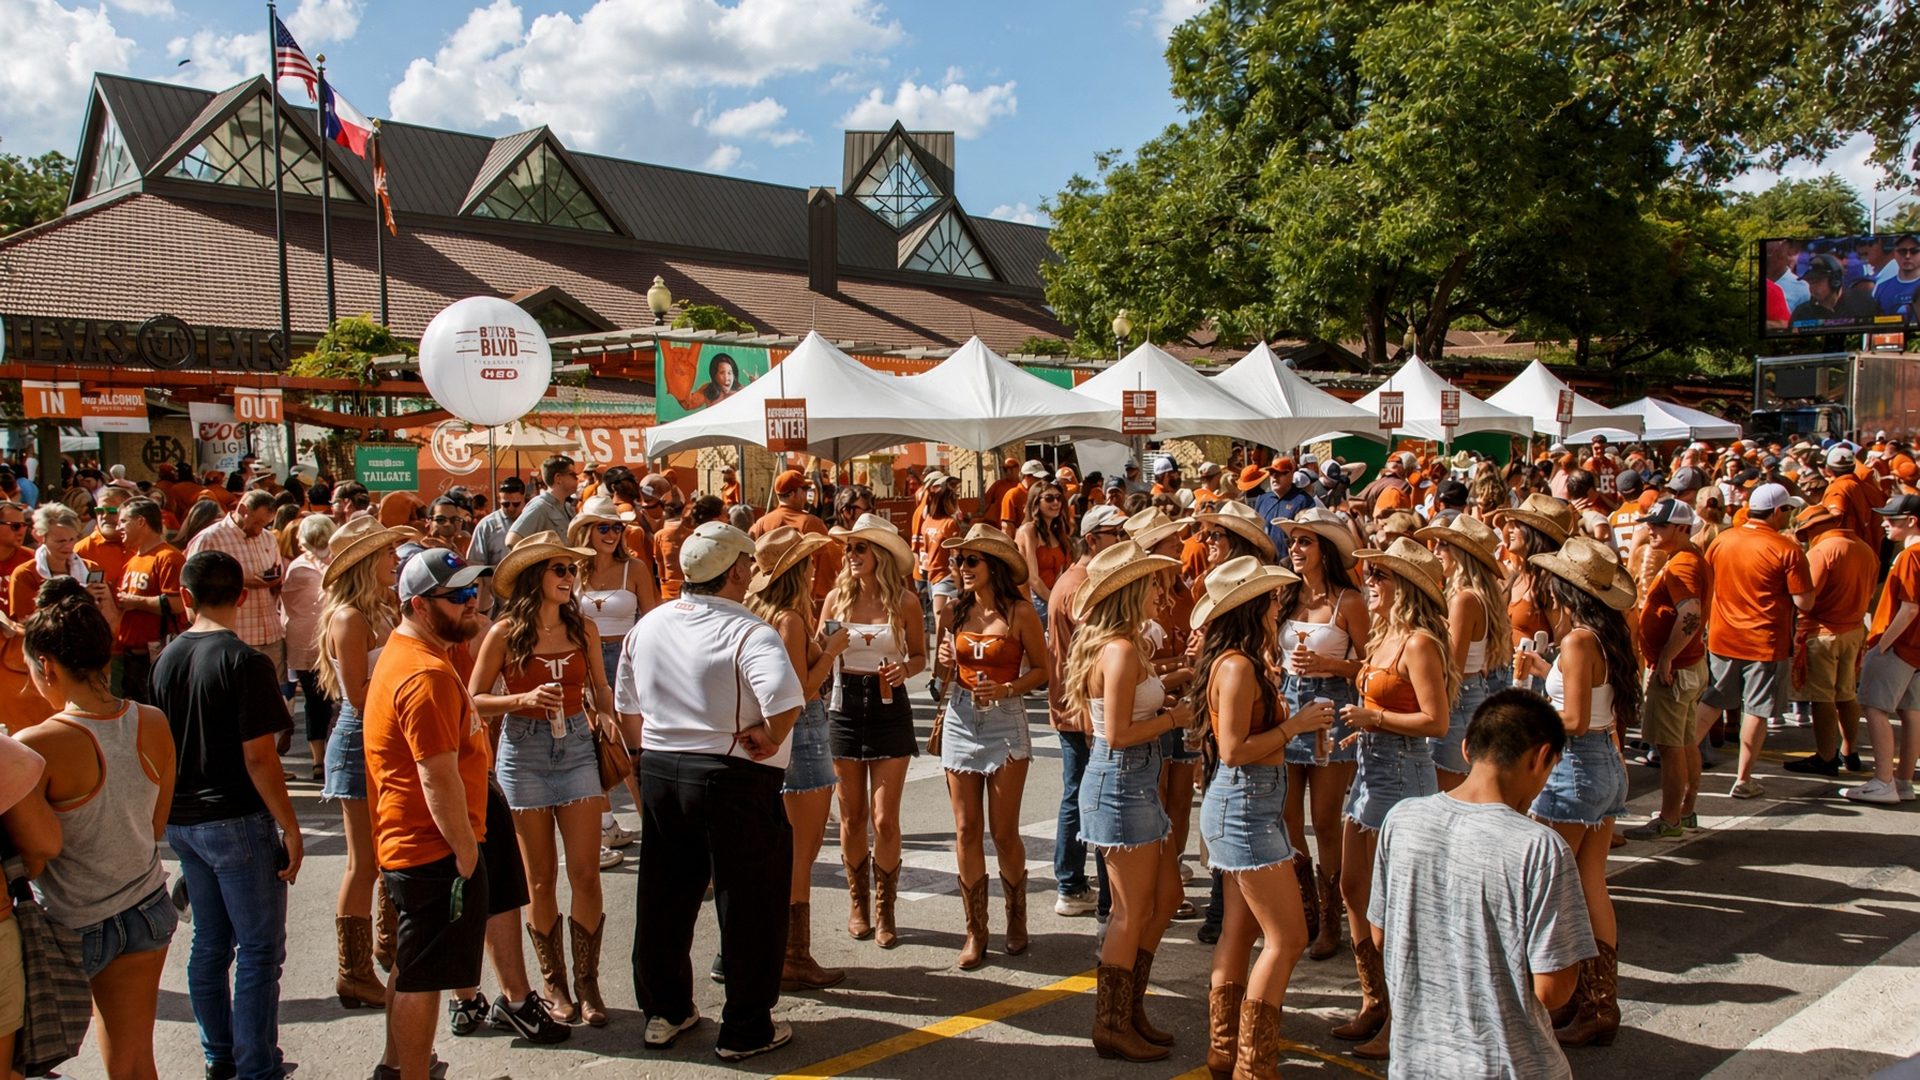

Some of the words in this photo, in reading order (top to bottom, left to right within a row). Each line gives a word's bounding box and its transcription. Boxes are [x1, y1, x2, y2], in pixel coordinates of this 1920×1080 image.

[480, 338, 518, 357] BLVD
[40, 391, 65, 414] IN
[98, 394, 144, 405] ALCOHOL
[240, 397, 279, 419] OUT
[1380, 404, 1403, 424] EXIT
[768, 418, 806, 439] ENTER
[363, 471, 411, 482] TAILGATE
